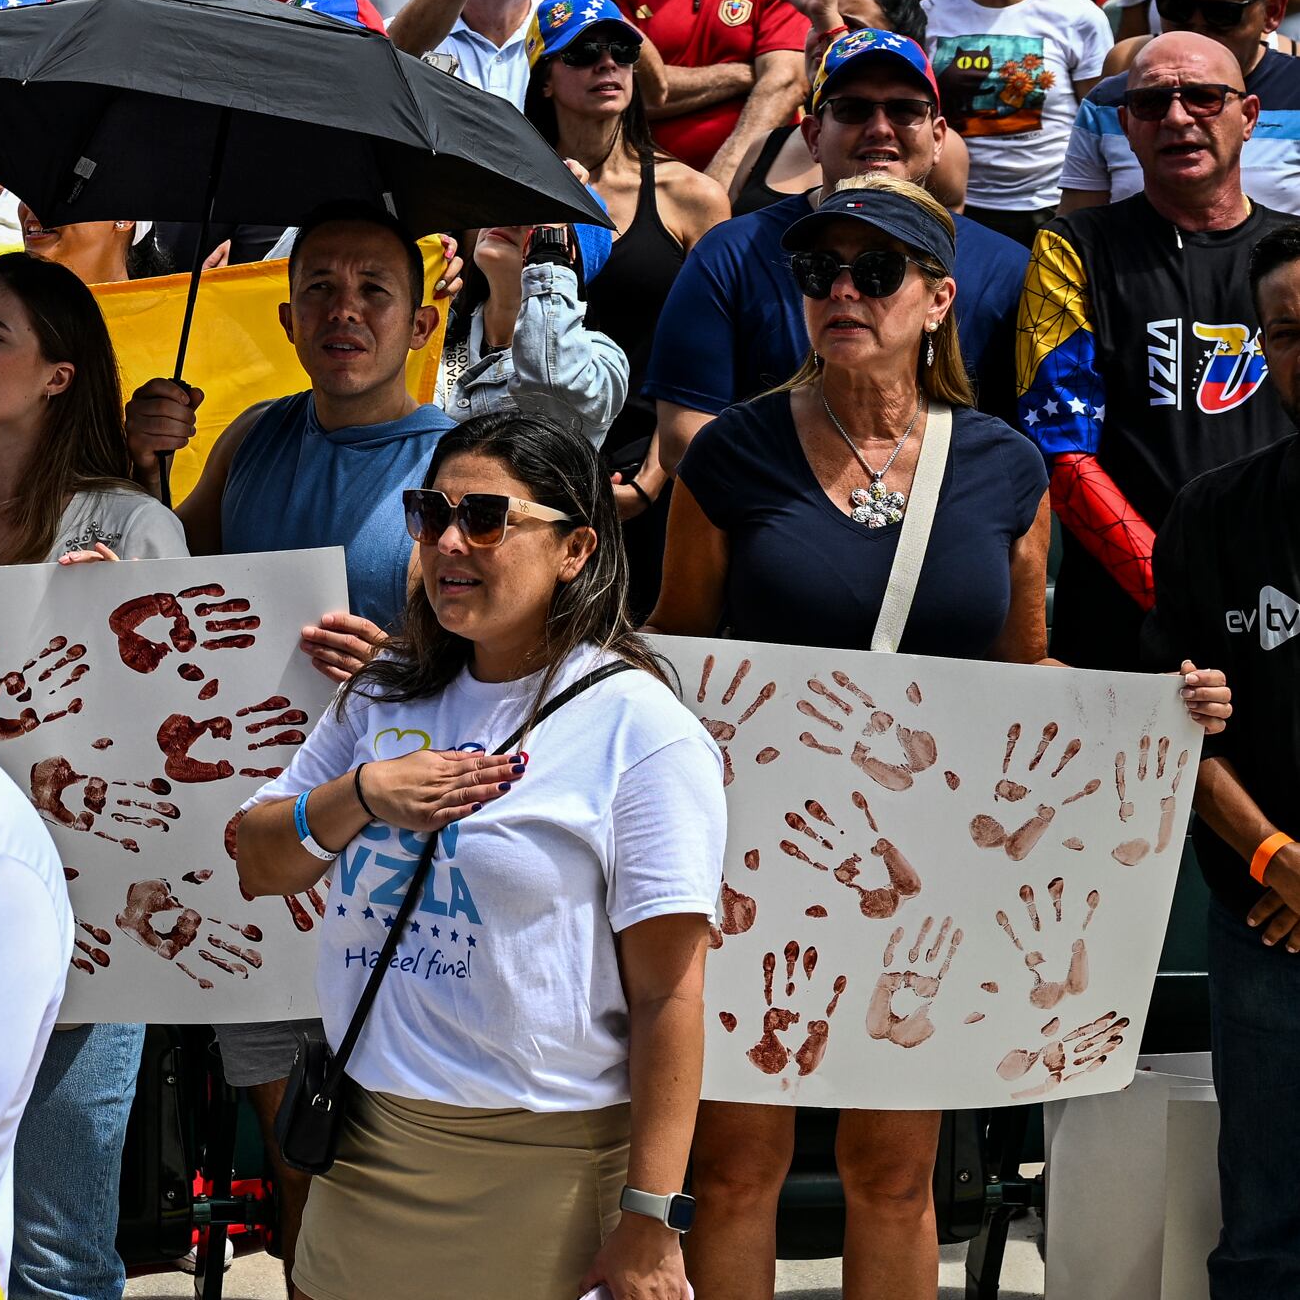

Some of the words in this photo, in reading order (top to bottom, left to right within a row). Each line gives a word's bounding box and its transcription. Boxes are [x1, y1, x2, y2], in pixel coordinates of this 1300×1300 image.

[1147, 319, 1177, 406] VZLA
[339, 845, 483, 925] VZLA
[425, 949, 472, 980] final
